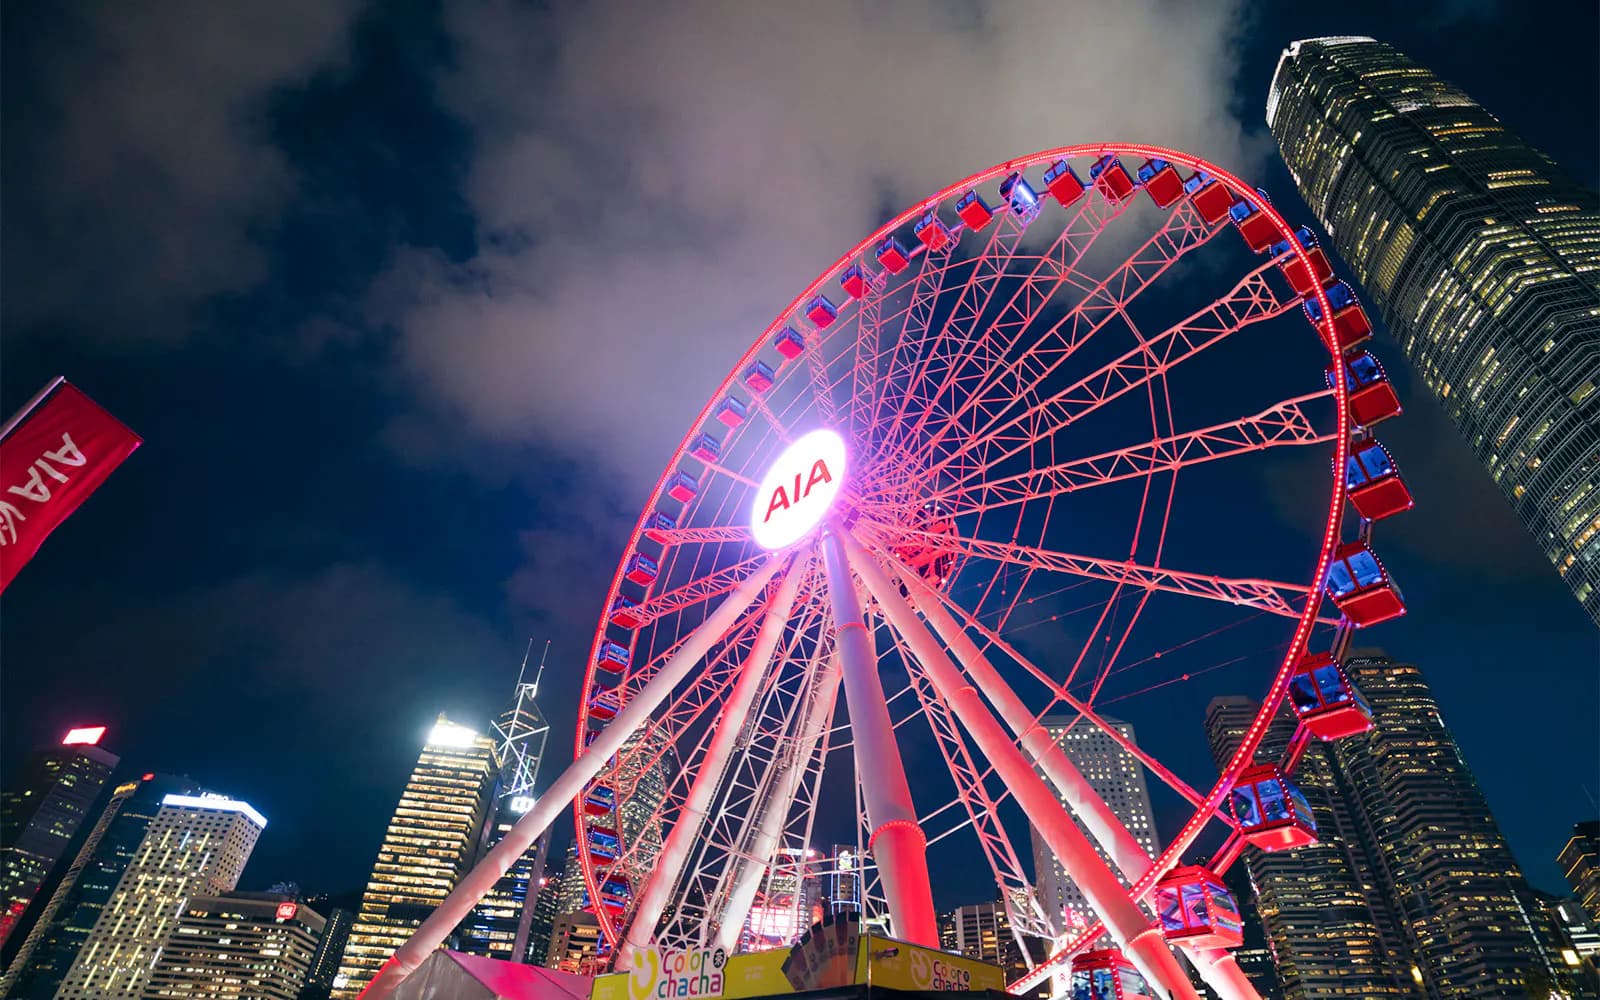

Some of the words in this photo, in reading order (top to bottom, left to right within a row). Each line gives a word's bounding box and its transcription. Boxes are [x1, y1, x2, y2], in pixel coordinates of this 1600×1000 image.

[8, 432, 87, 502] AIA
[763, 459, 832, 523] AIA
[663, 947, 709, 974] Color
[658, 972, 721, 998] chacha
